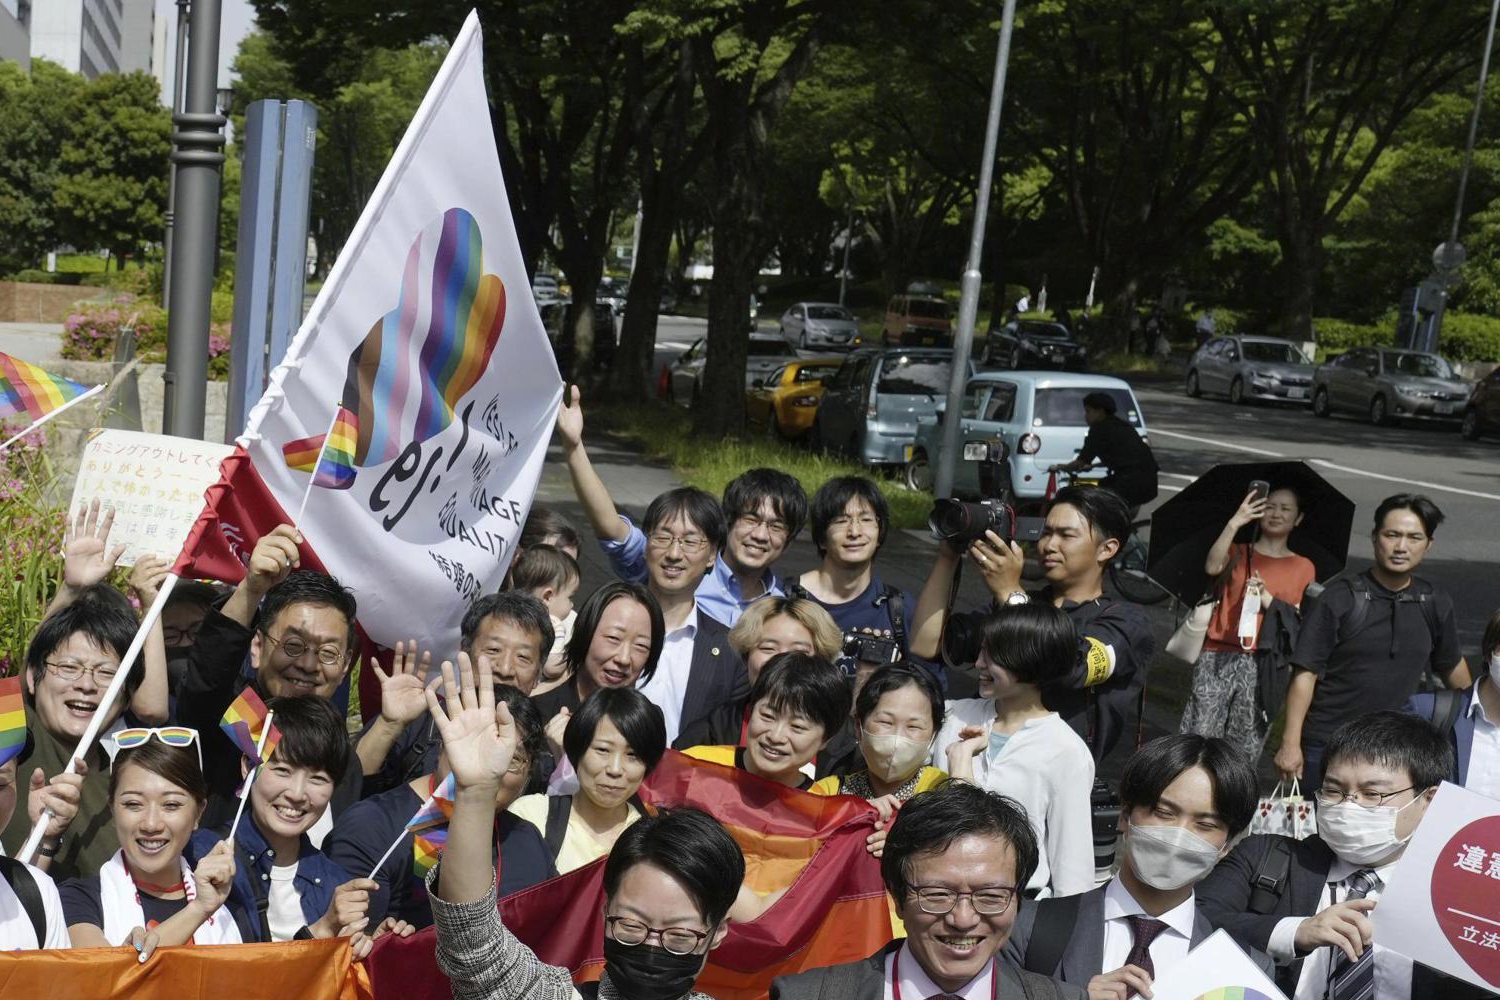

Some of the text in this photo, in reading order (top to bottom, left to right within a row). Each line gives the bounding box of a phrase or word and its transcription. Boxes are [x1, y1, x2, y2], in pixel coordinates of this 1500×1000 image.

[91, 441, 222, 469] カミングアウトしてく
